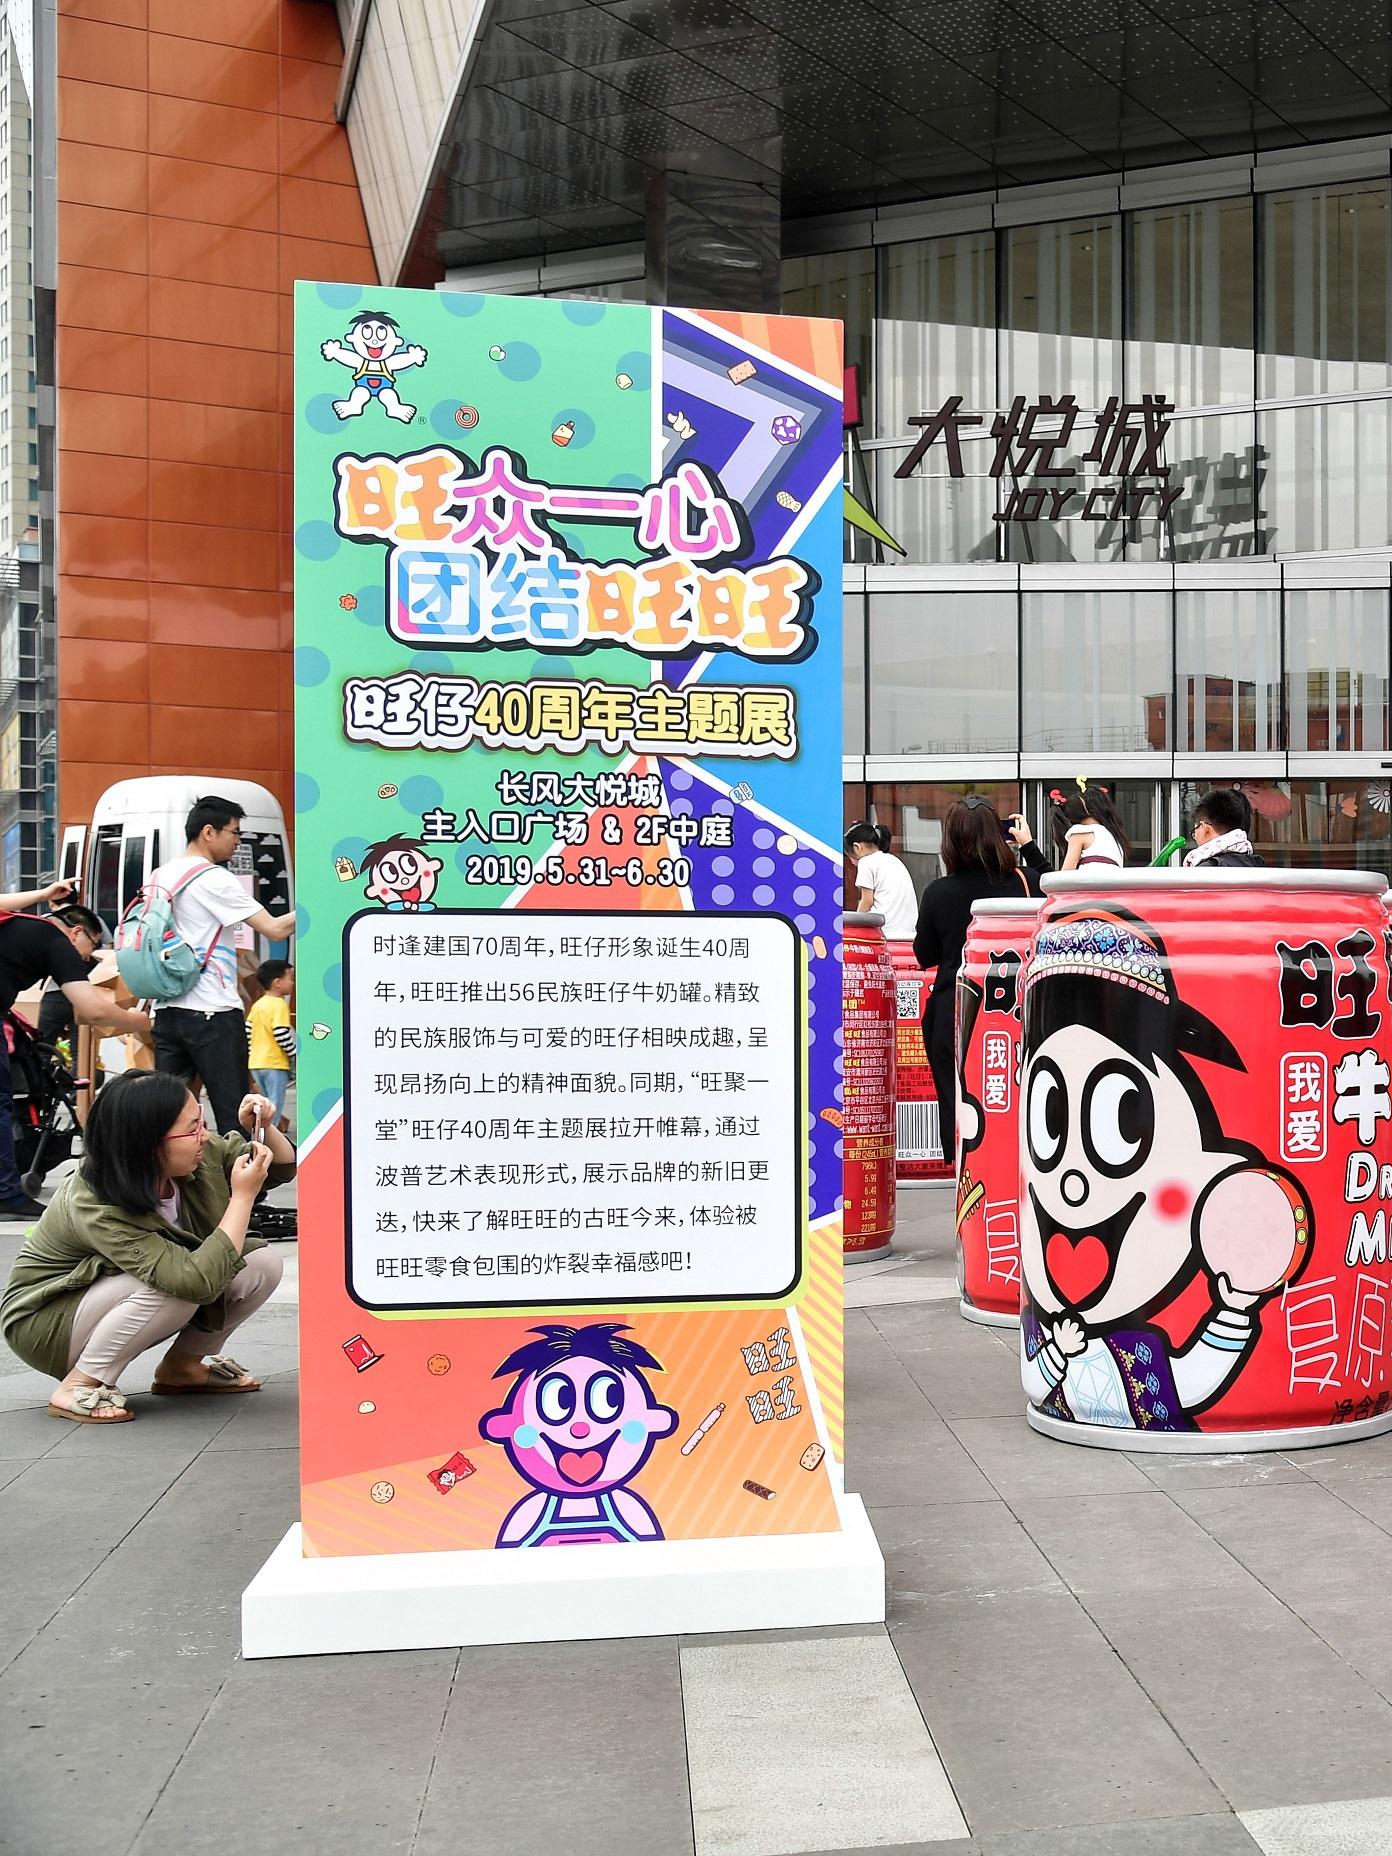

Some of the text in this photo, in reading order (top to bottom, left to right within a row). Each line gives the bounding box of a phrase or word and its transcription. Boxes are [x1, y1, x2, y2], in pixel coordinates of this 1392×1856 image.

[894, 394, 1176, 479] 大悦城
[340, 450, 738, 558] 旺众一心
[992, 486, 1185, 521] JOY CITY
[396, 549, 804, 652] 团结旺旺
[350, 680, 792, 746] 旺仔40周年主题展
[498, 771, 660, 808] 长风大悦城
[422, 810, 733, 848] 主入口广场 & 2F中庭
[466, 856, 691, 887] 2019.5.31~6.30
[373, 935, 750, 959] 时逢建国70周年，旺仔形象诞生40周
[373, 981, 760, 1003] 年，旺旺推出56民族旺仔牛奶罐。精致
[374, 1026, 769, 1049] 的民族服饰与可爱的旺仔相映成趣，呈
[985, 1037, 1008, 1107] 我爱
[1287, 1062, 1322, 1153] 我爱
[375, 1160, 770, 1187] 波普艺术表现形式，展示品牌的新旧更
[375, 1204, 757, 1233] 迭，快来了解旺旺的古旺今来，体验被
